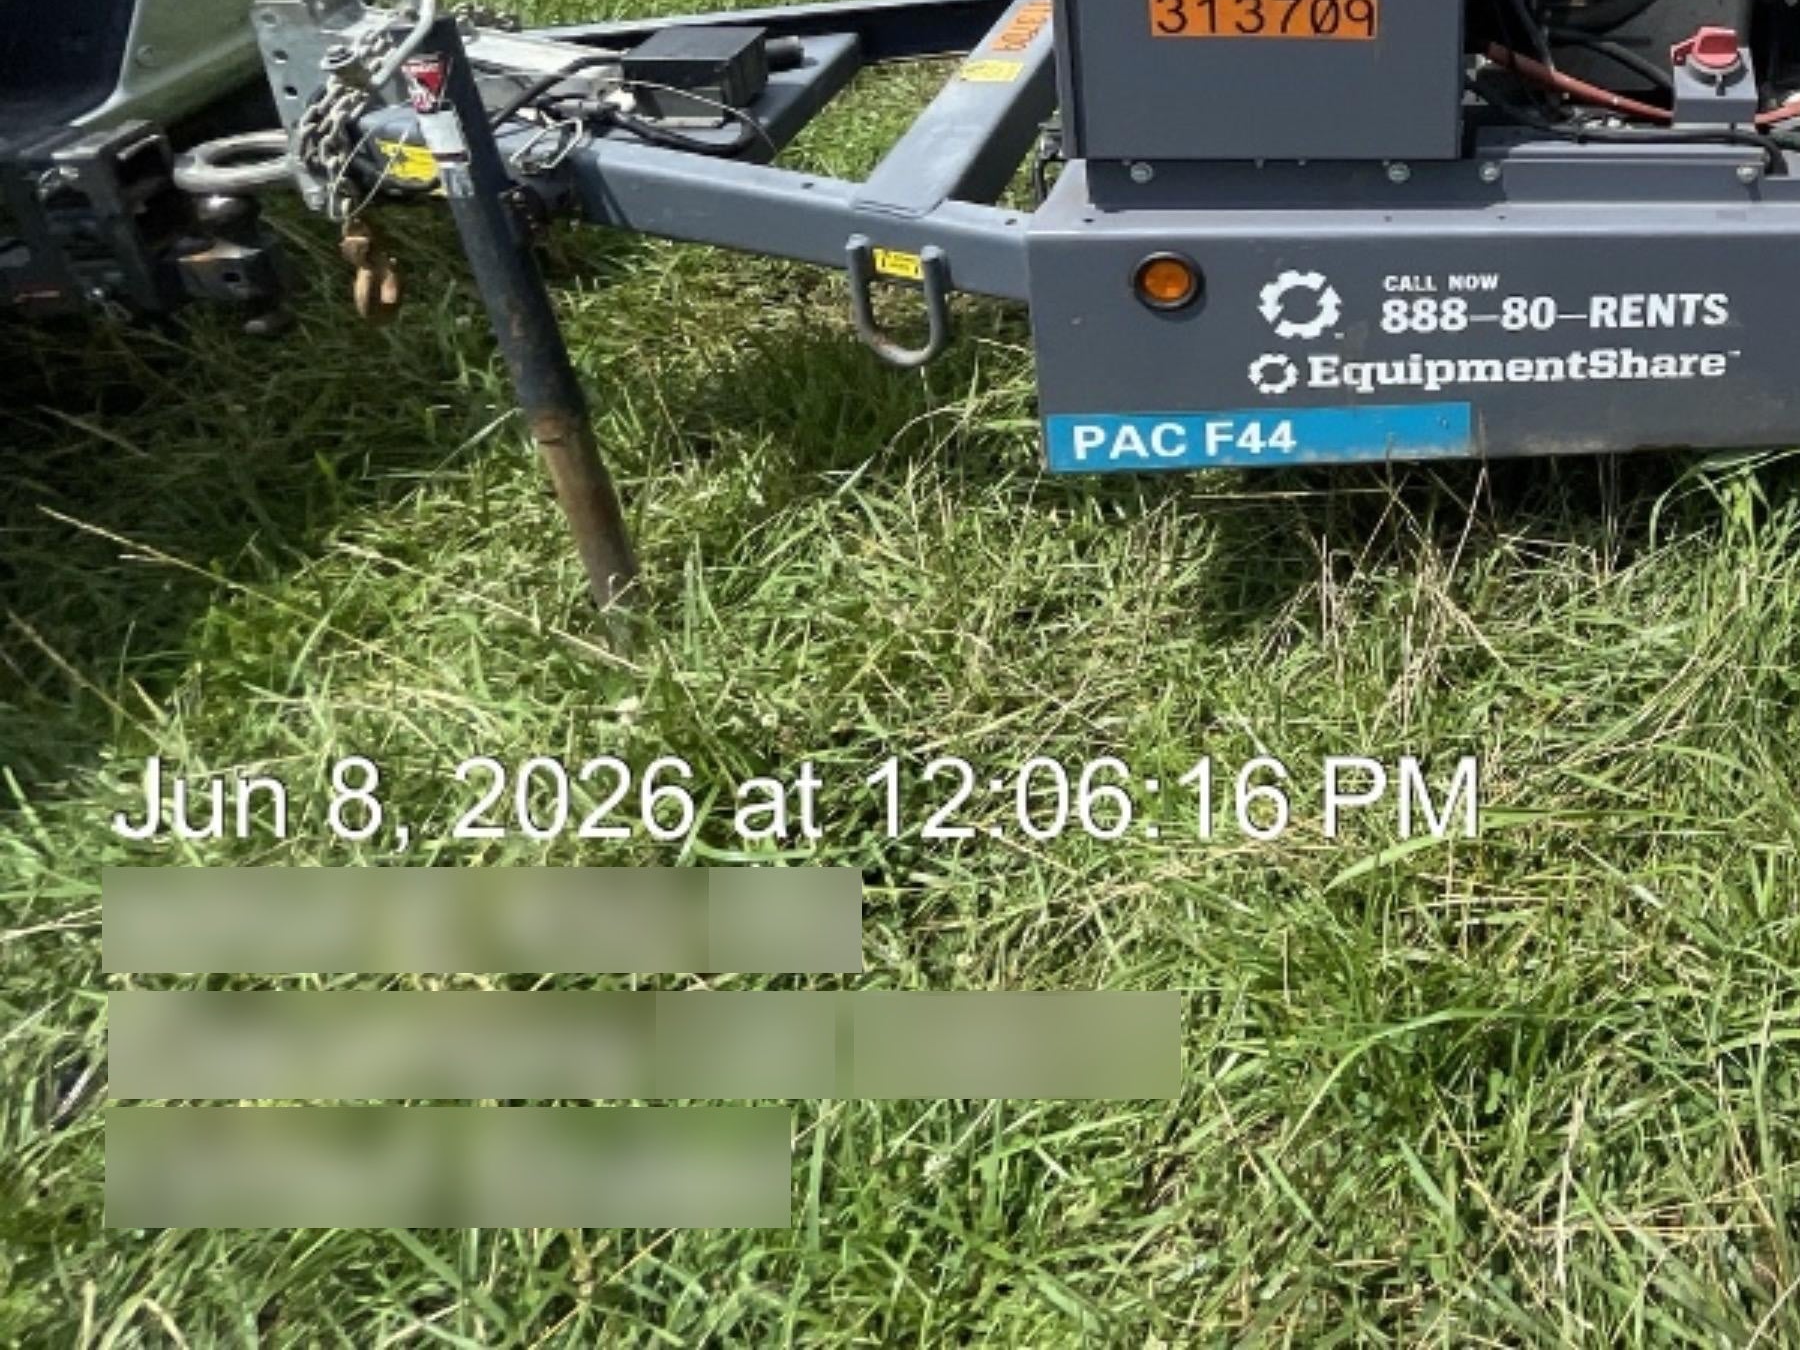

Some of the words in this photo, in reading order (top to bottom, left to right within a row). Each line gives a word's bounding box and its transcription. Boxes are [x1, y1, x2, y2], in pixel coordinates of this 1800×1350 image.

[1383, 275, 1437, 292] CALL
[1448, 273, 1500, 291] NOW
[1073, 423, 1186, 460] PAC
[1205, 420, 1297, 457] F44
